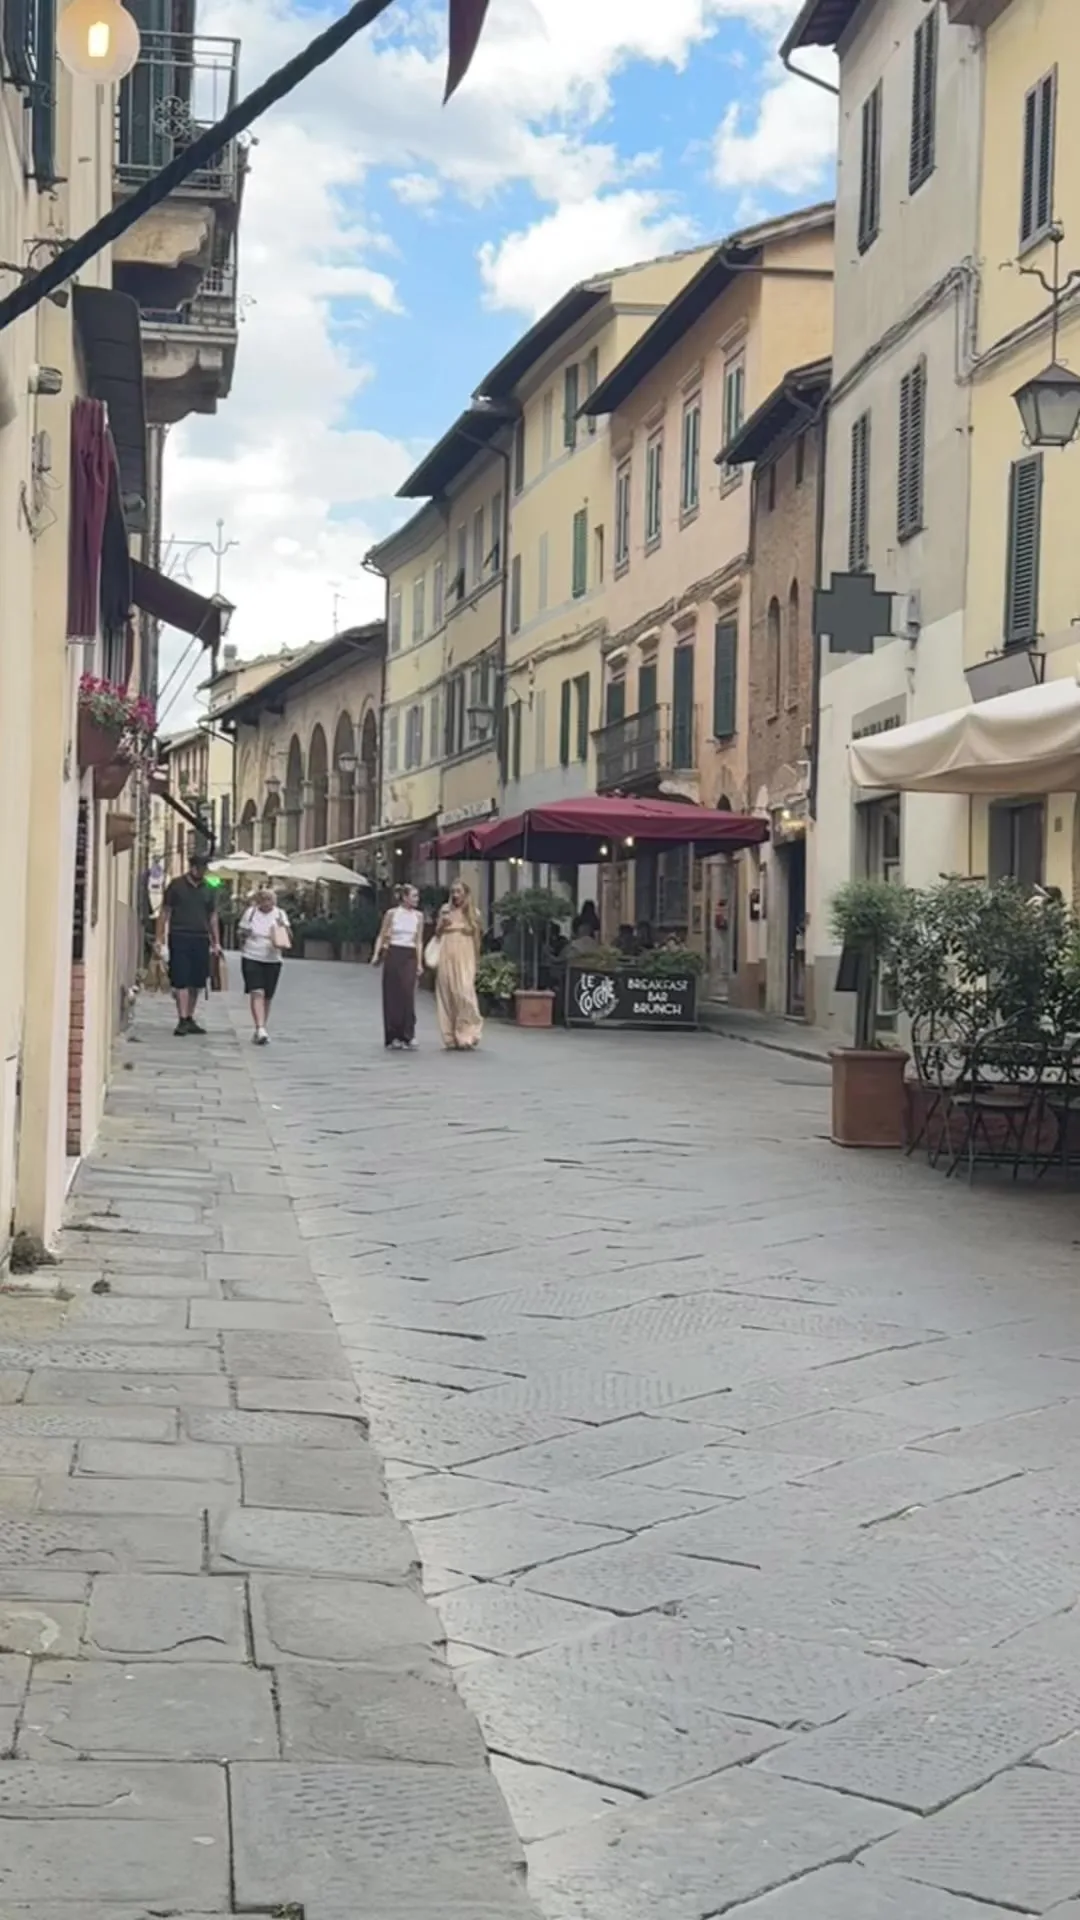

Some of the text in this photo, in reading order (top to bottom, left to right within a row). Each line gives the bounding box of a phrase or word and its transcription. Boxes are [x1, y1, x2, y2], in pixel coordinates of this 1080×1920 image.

[581, 973, 596, 990] LE
[627, 978, 688, 991] BREAKFAST
[647, 991, 668, 1002] BAR
[633, 1002, 682, 1015] BRUNCH
